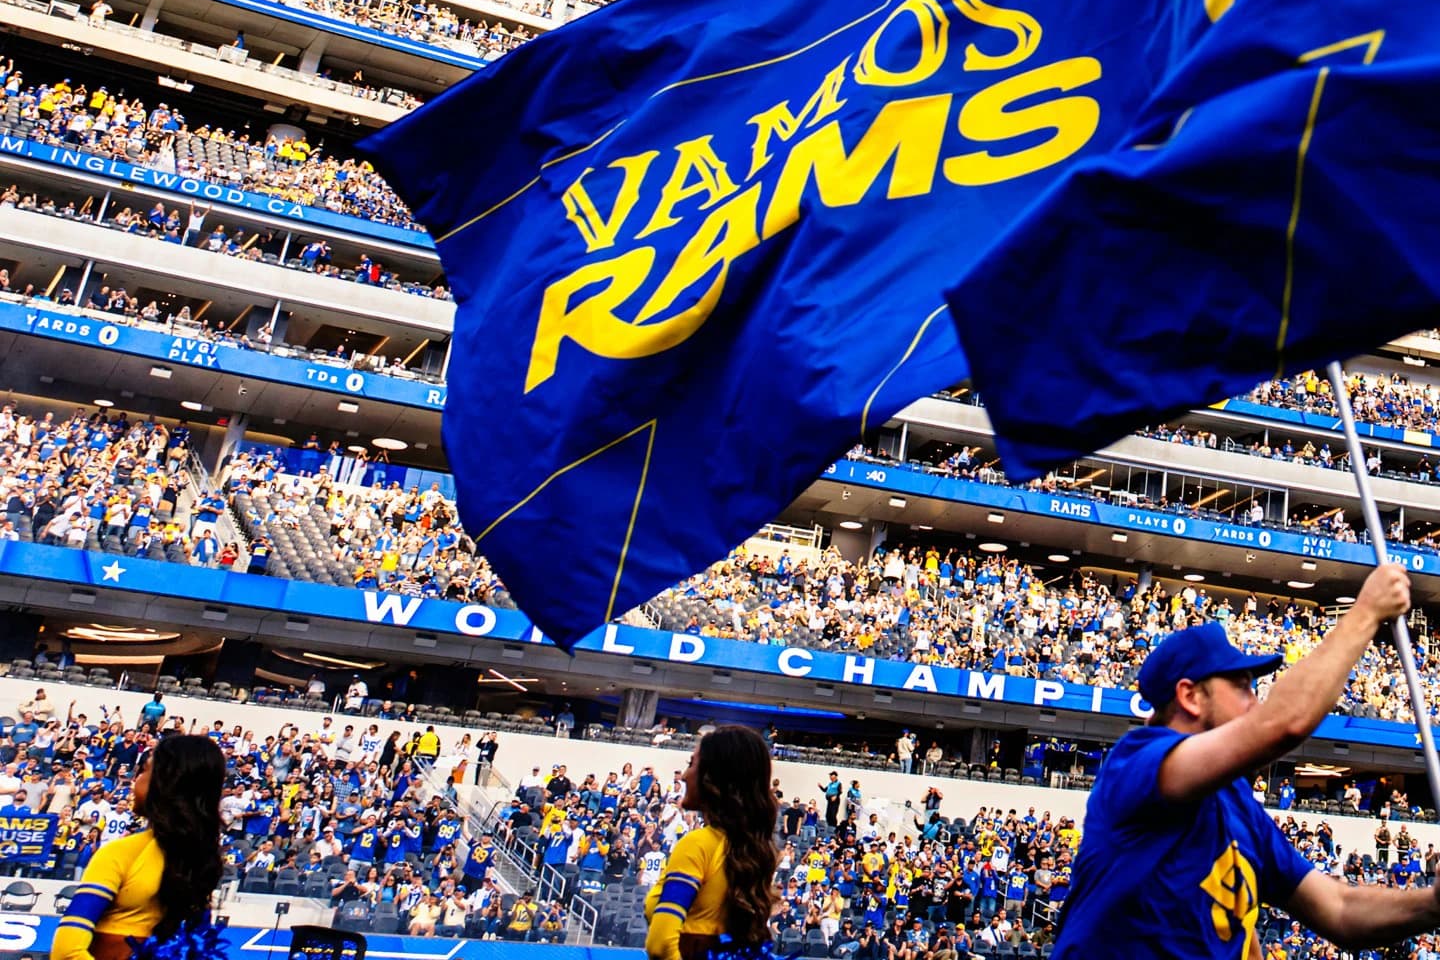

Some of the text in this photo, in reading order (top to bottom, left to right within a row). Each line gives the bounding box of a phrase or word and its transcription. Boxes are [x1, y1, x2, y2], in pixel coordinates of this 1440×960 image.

[267, 199, 305, 218] CA
[524, 56, 1102, 395] RAMS
[26, 314, 120, 346] YARDS 0
[172, 338, 220, 355] AVG/
[169, 349, 217, 367] PLAY
[306, 369, 364, 392] TDs 0
[1051, 499, 1091, 518] RAMS
[1129, 514, 1186, 534] PLAYS 0
[1214, 527, 1271, 547] YARDS 0
[1302, 546, 1332, 558] PLAY
[1412, 555, 1425, 570] 0
[108, 820, 127, 834] 99
[438, 824, 455, 838] 99
[361, 833, 374, 848] 12
